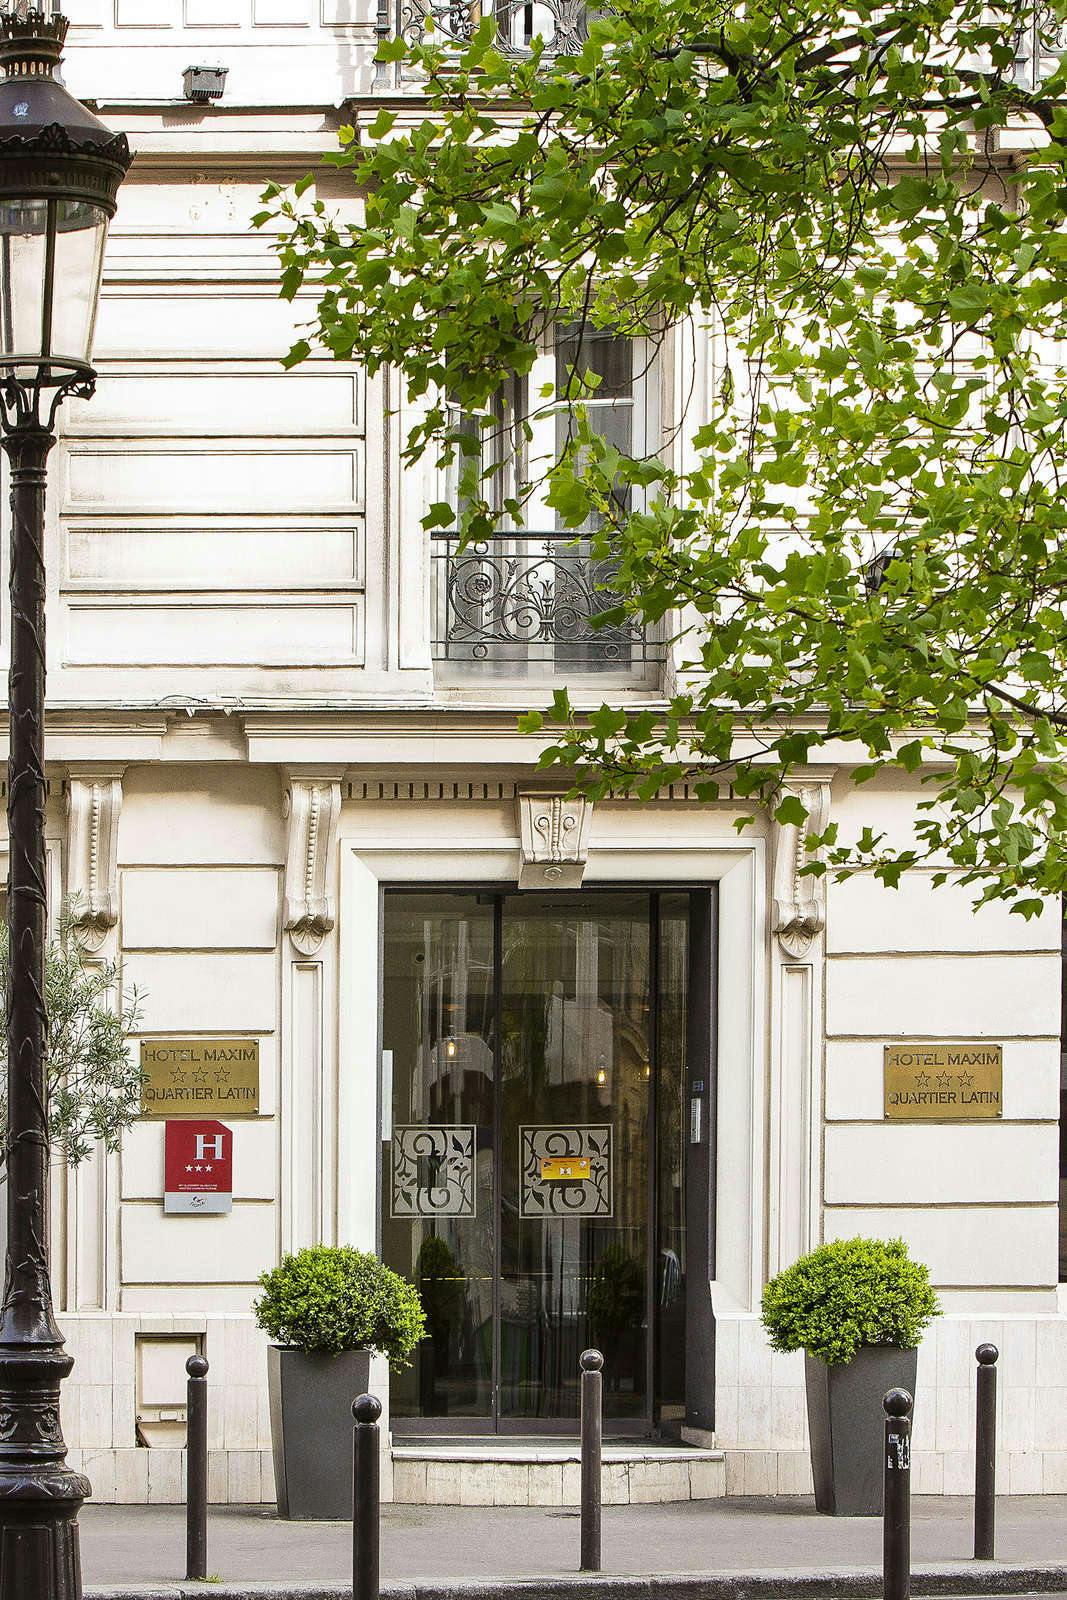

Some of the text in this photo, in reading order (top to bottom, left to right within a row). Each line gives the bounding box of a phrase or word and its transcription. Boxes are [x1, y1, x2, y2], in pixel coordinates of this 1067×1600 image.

[144, 1048, 256, 1062] HOTEL MAXIM
[888, 1052, 999, 1066] HOTEL MAXIM
[145, 1087, 256, 1101] QUARTIER LATIN
[888, 1091, 999, 1105] QUARTIER LATIN
[193, 1134, 226, 1160] H
